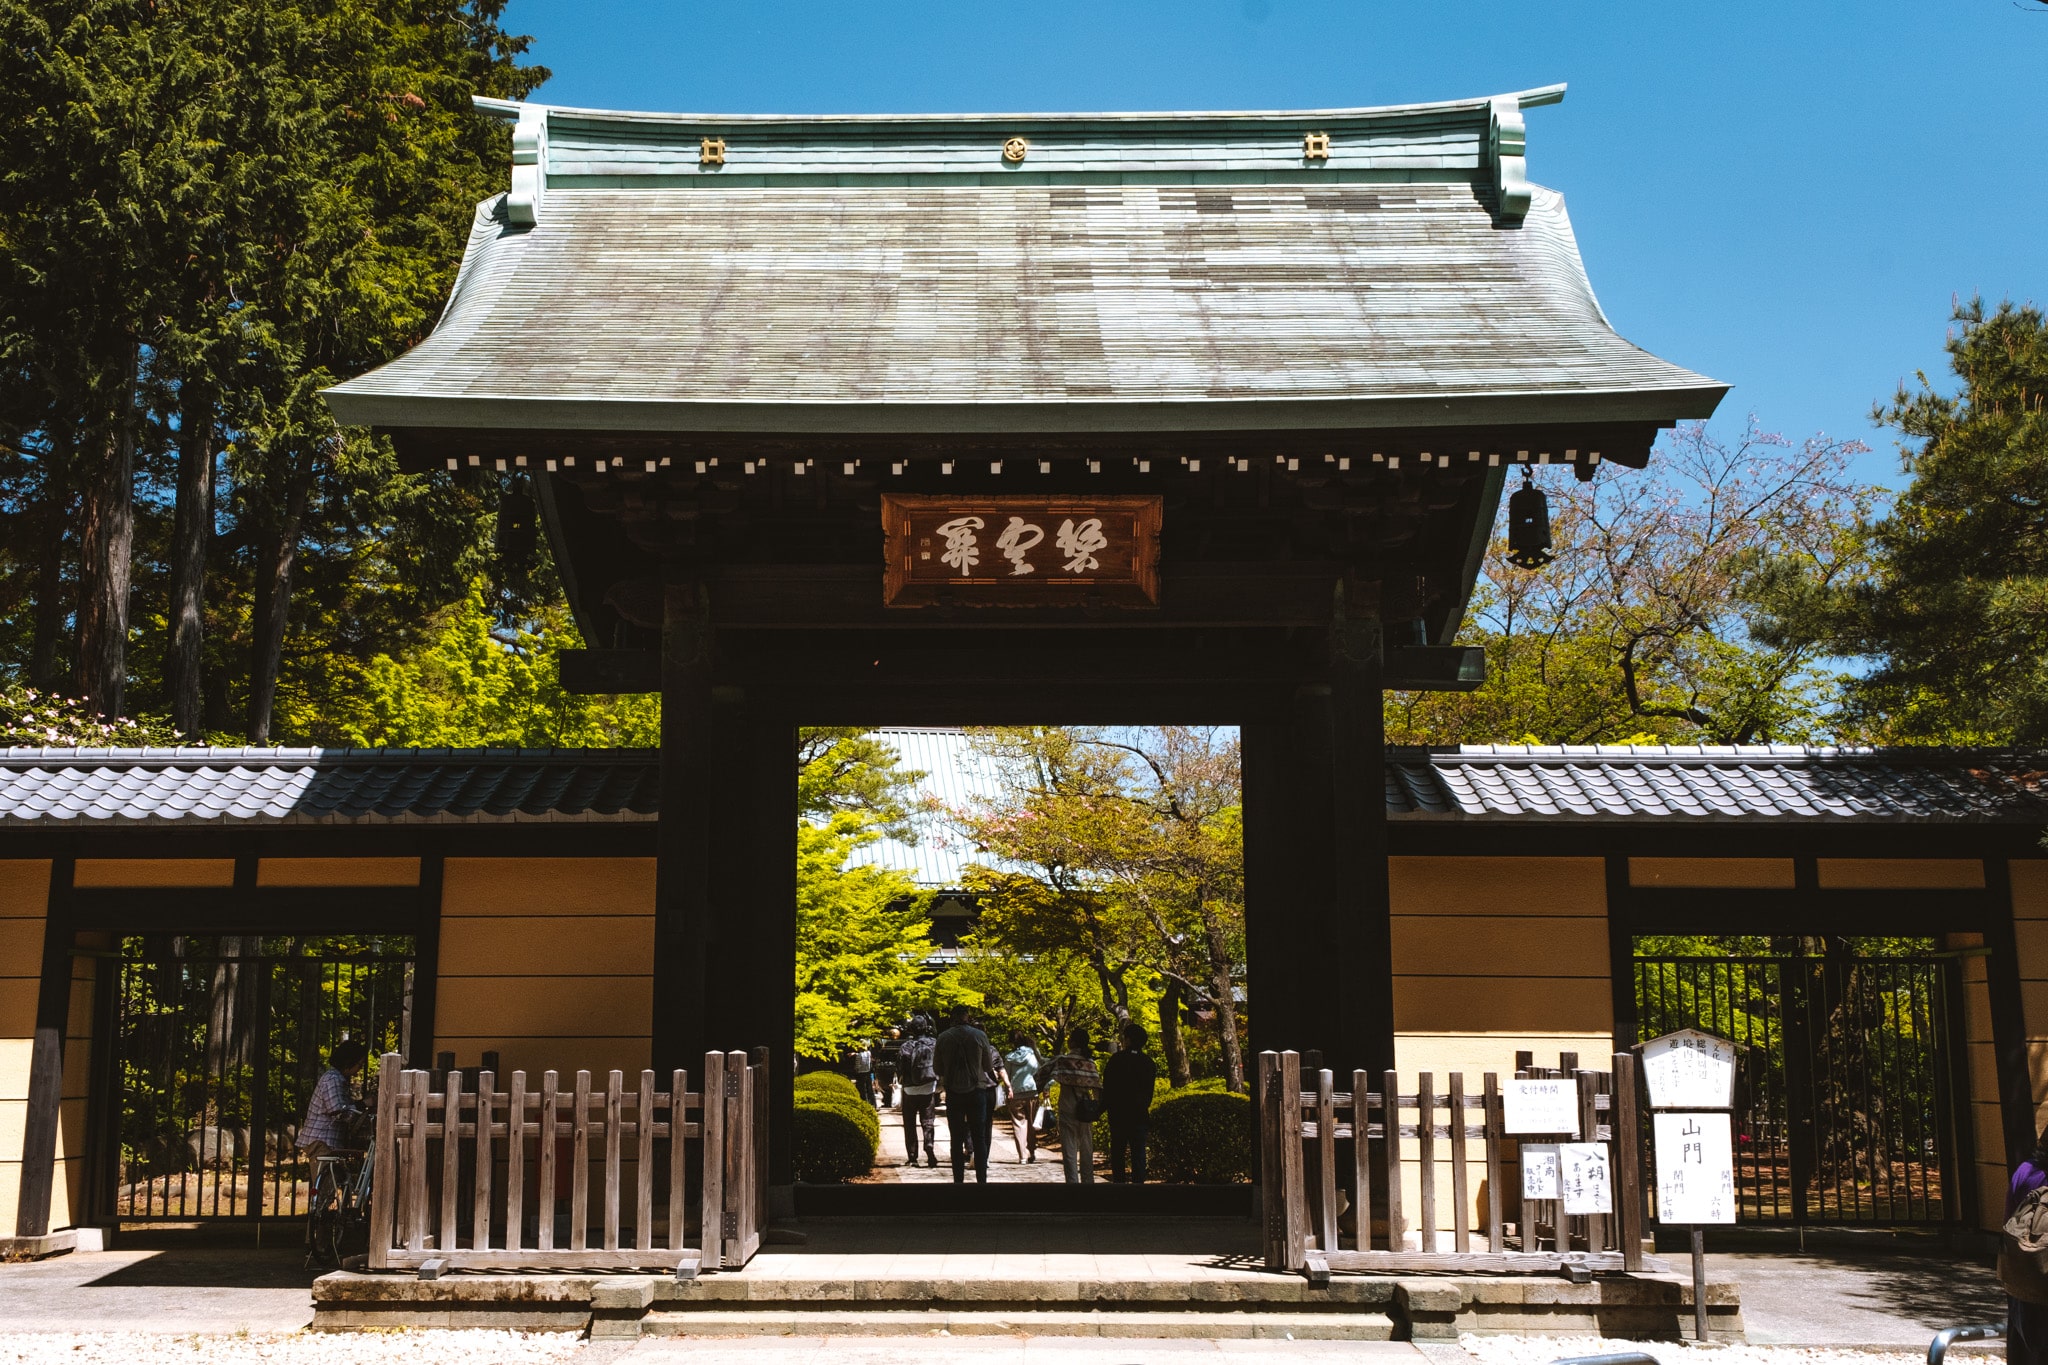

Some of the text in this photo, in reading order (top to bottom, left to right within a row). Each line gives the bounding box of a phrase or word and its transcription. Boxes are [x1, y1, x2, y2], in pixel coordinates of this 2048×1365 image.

[1519, 1084, 1559, 1095] 受付時間
[1681, 1118, 1702, 1165] 山門
[1673, 1169, 1685, 1194] 閉門
[1721, 1170, 1732, 1194] 開門
[1662, 1183, 1674, 1220] 十七時
[1711, 1196, 1721, 1221] 六時
